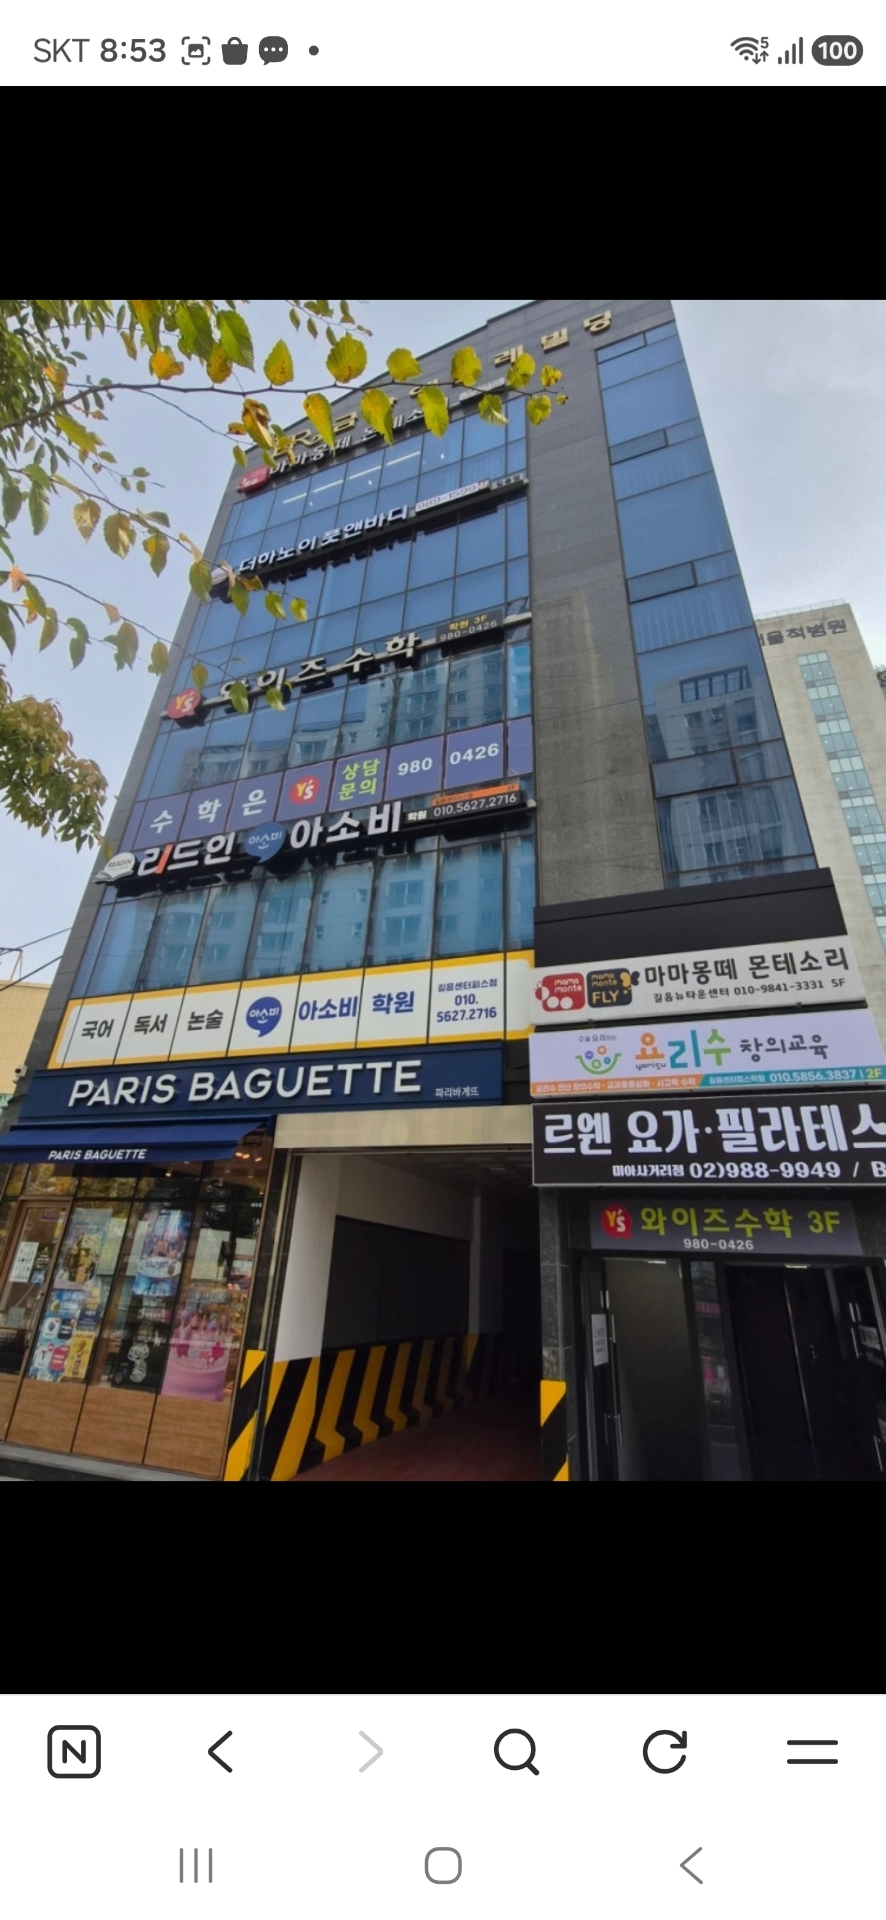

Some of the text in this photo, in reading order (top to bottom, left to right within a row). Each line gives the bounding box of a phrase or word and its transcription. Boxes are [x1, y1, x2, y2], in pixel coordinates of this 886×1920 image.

[474, 614, 488, 624] 3F
[440, 620, 497, 642] 980-0426
[343, 759, 381, 781] 상담
[398, 743, 500, 776] 980 0426
[339, 780, 377, 801] 문의
[137, 832, 235, 876] 리드인
[290, 803, 401, 848] 아소비
[408, 810, 428, 822] 학원
[434, 793, 517, 817] 010.5627.2716
[645, 947, 849, 987] 마마몽떼 몬테소리
[554, 978, 579, 986] mama
[555, 985, 583, 993] monte
[653, 978, 845, 1004] 길음뉴타운센터 010-9841-3331 5F
[454, 994, 479, 1006] 010.
[592, 990, 619, 1004] FLY
[82, 1018, 112, 1040] 국어
[134, 1013, 167, 1037] 독서
[188, 1008, 224, 1032] 논술
[299, 997, 358, 1022] 아소비
[373, 991, 414, 1015] 학원
[436, 1007, 497, 1022] 5627.2716
[635, 1029, 828, 1068] 요리수 창의교육
[68, 1060, 423, 1107] PARIS BAGUETTE
[769, 1069, 856, 1083] 010.5856.3837
[866, 1068, 882, 1079] 2F
[435, 1086, 479, 1098] 파리바게뜨
[543, 1112, 612, 1155] 르웬
[48, 1149, 147, 1161] PARIS BAGUETTE
[612, 1164, 684, 1177] 미아사거리점
[689, 1161, 840, 1178] 02)988-9949
[641, 1206, 792, 1239] 와이즈수학
[808, 1210, 840, 1234] 3F
[683, 1238, 754, 1250] 980-0426
